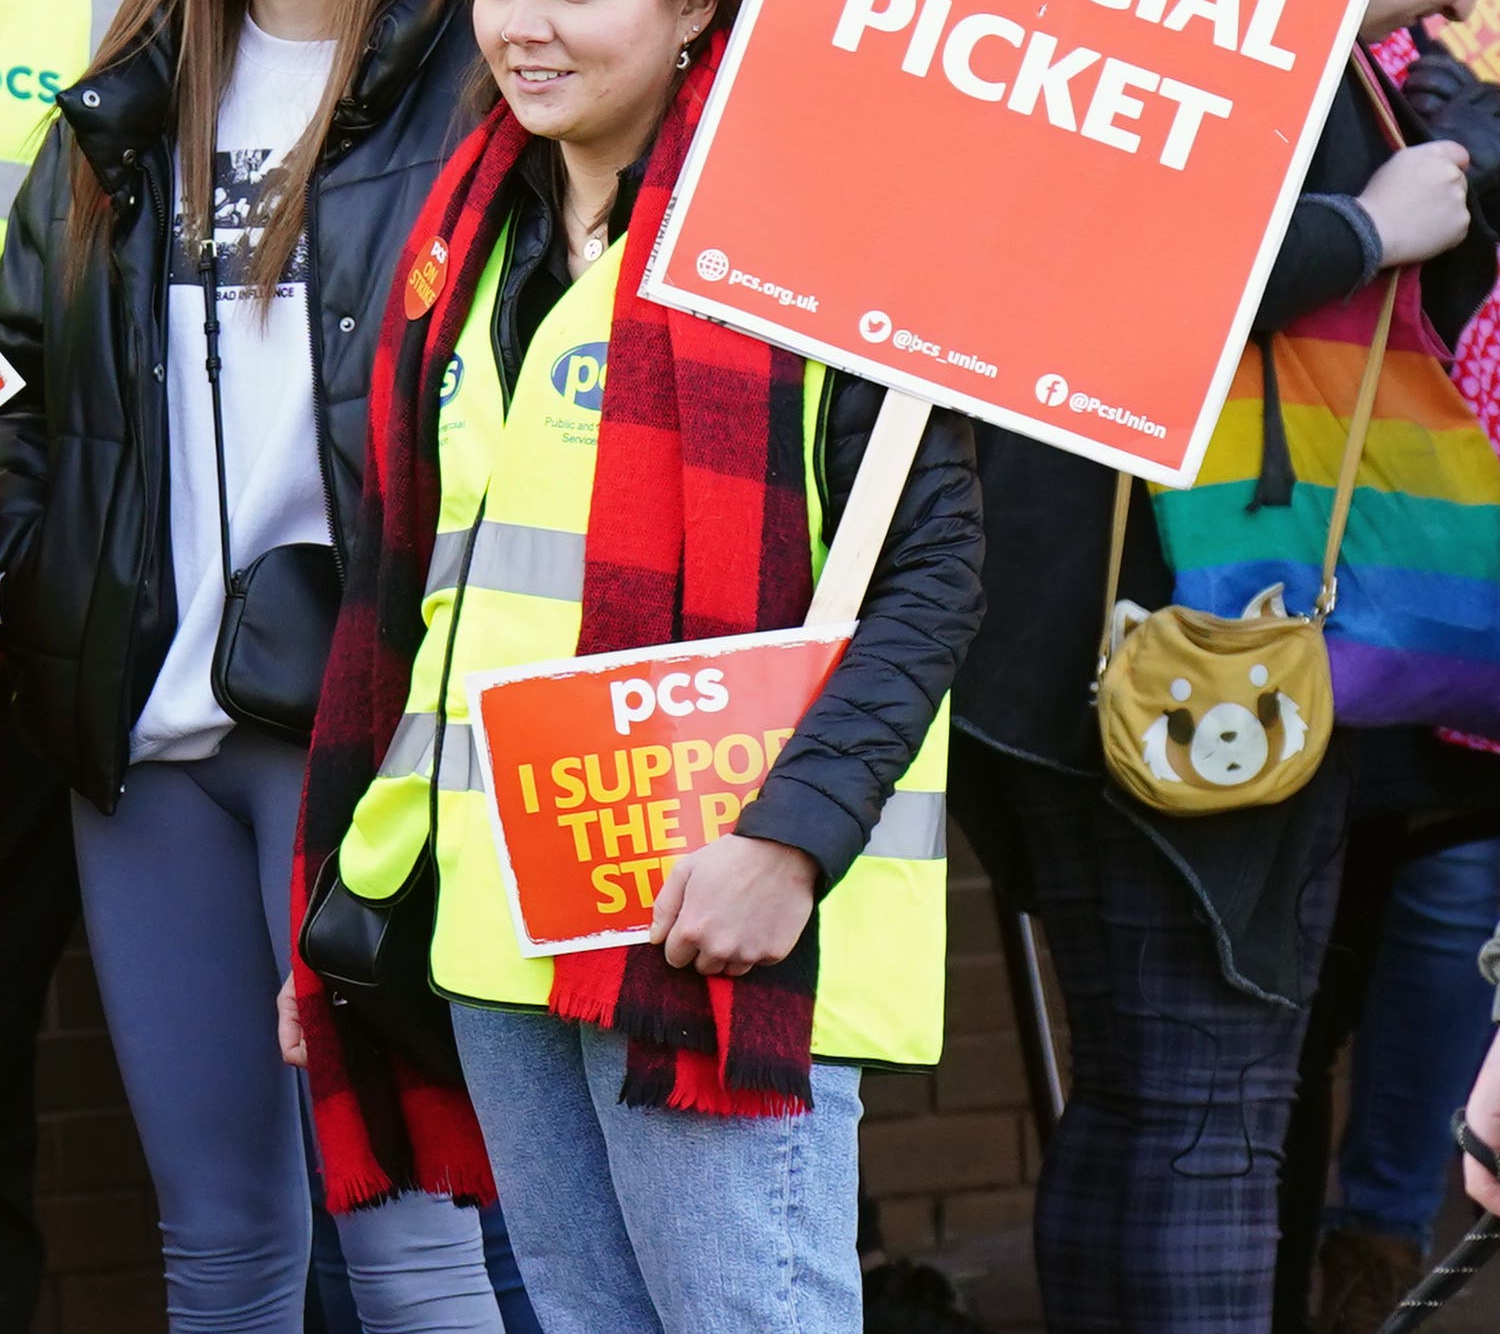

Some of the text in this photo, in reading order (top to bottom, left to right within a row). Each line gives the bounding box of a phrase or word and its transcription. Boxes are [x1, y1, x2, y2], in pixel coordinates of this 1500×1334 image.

[728, 267, 820, 314] pcs.org.uk
[1068, 391, 1168, 441] @PcsUnion
[610, 668, 730, 736] pcs
[518, 763, 540, 814] I
[557, 797, 687, 863] THE
